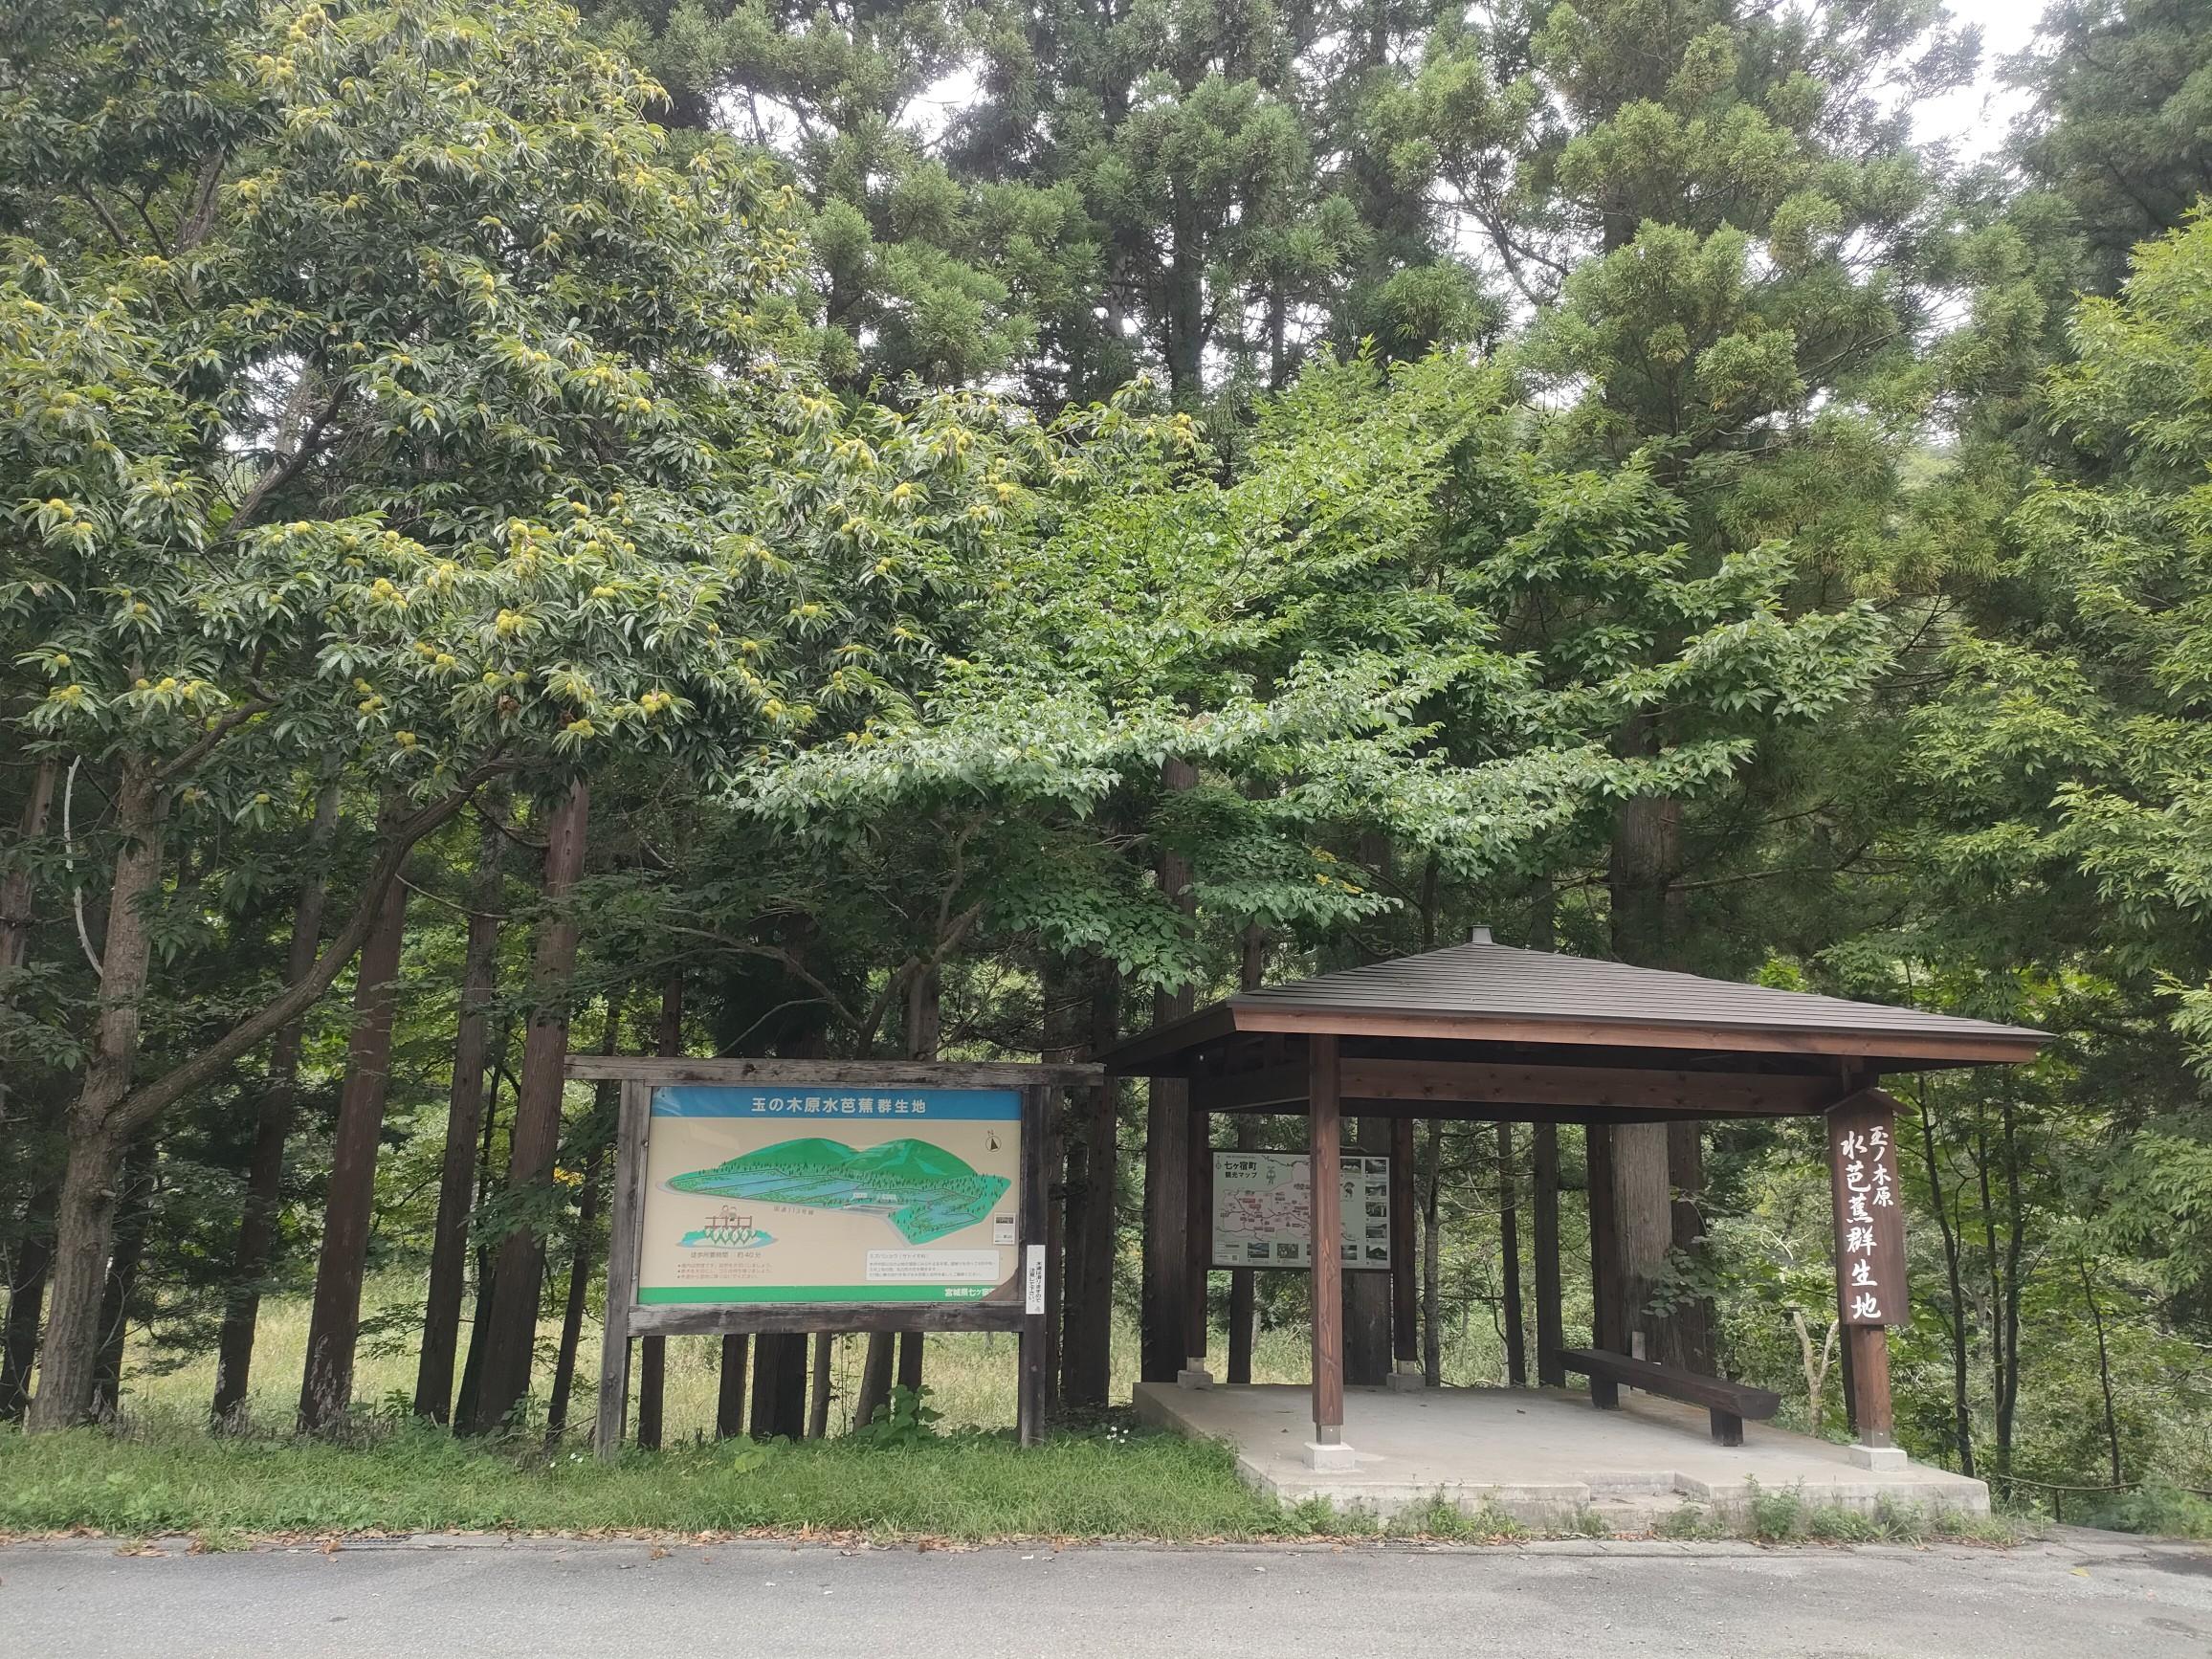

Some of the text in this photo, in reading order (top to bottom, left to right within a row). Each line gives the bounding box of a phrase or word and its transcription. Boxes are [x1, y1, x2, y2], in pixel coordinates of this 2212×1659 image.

[751, 1096, 926, 1114] 玉の木原水芭蕉群生地
[1840, 1130, 1882, 1320] 水芭蕉群生地
